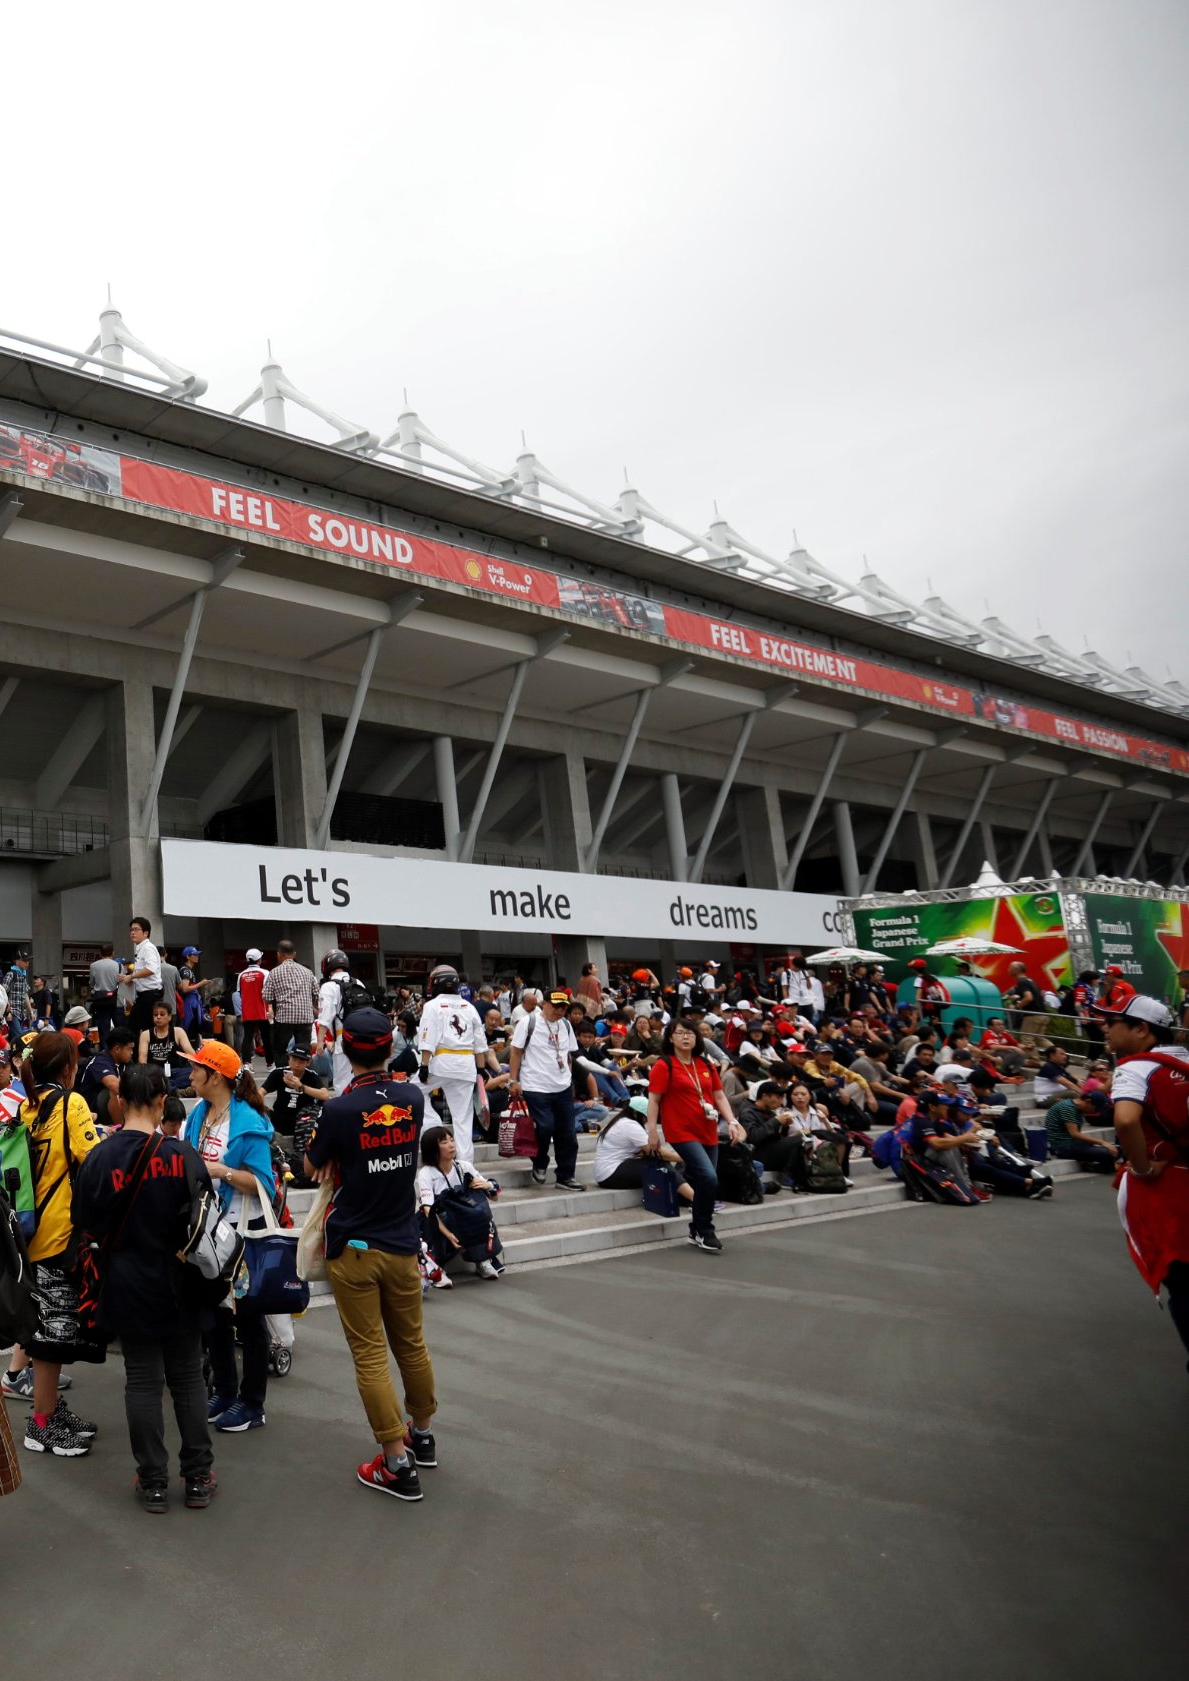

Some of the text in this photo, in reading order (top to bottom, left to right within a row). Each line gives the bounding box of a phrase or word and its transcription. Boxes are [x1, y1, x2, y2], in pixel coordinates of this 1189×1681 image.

[211, 487, 414, 564] FEEL SOUND
[487, 564, 504, 576] Shell
[488, 573, 530, 594] V-Power
[710, 623, 857, 682] FEEL EXCITEMENT
[258, 864, 351, 907] Let's
[489, 884, 572, 921] make
[669, 896, 758, 931] dreams
[869, 915, 920, 927] Formula 1
[1096, 919, 1126, 934] Formula
[871, 928, 918, 938] Japanese
[872, 937, 929, 948] Grand Prix
[359, 1124, 416, 1150] Red Bull
[368, 1154, 403, 1174] Mobil
